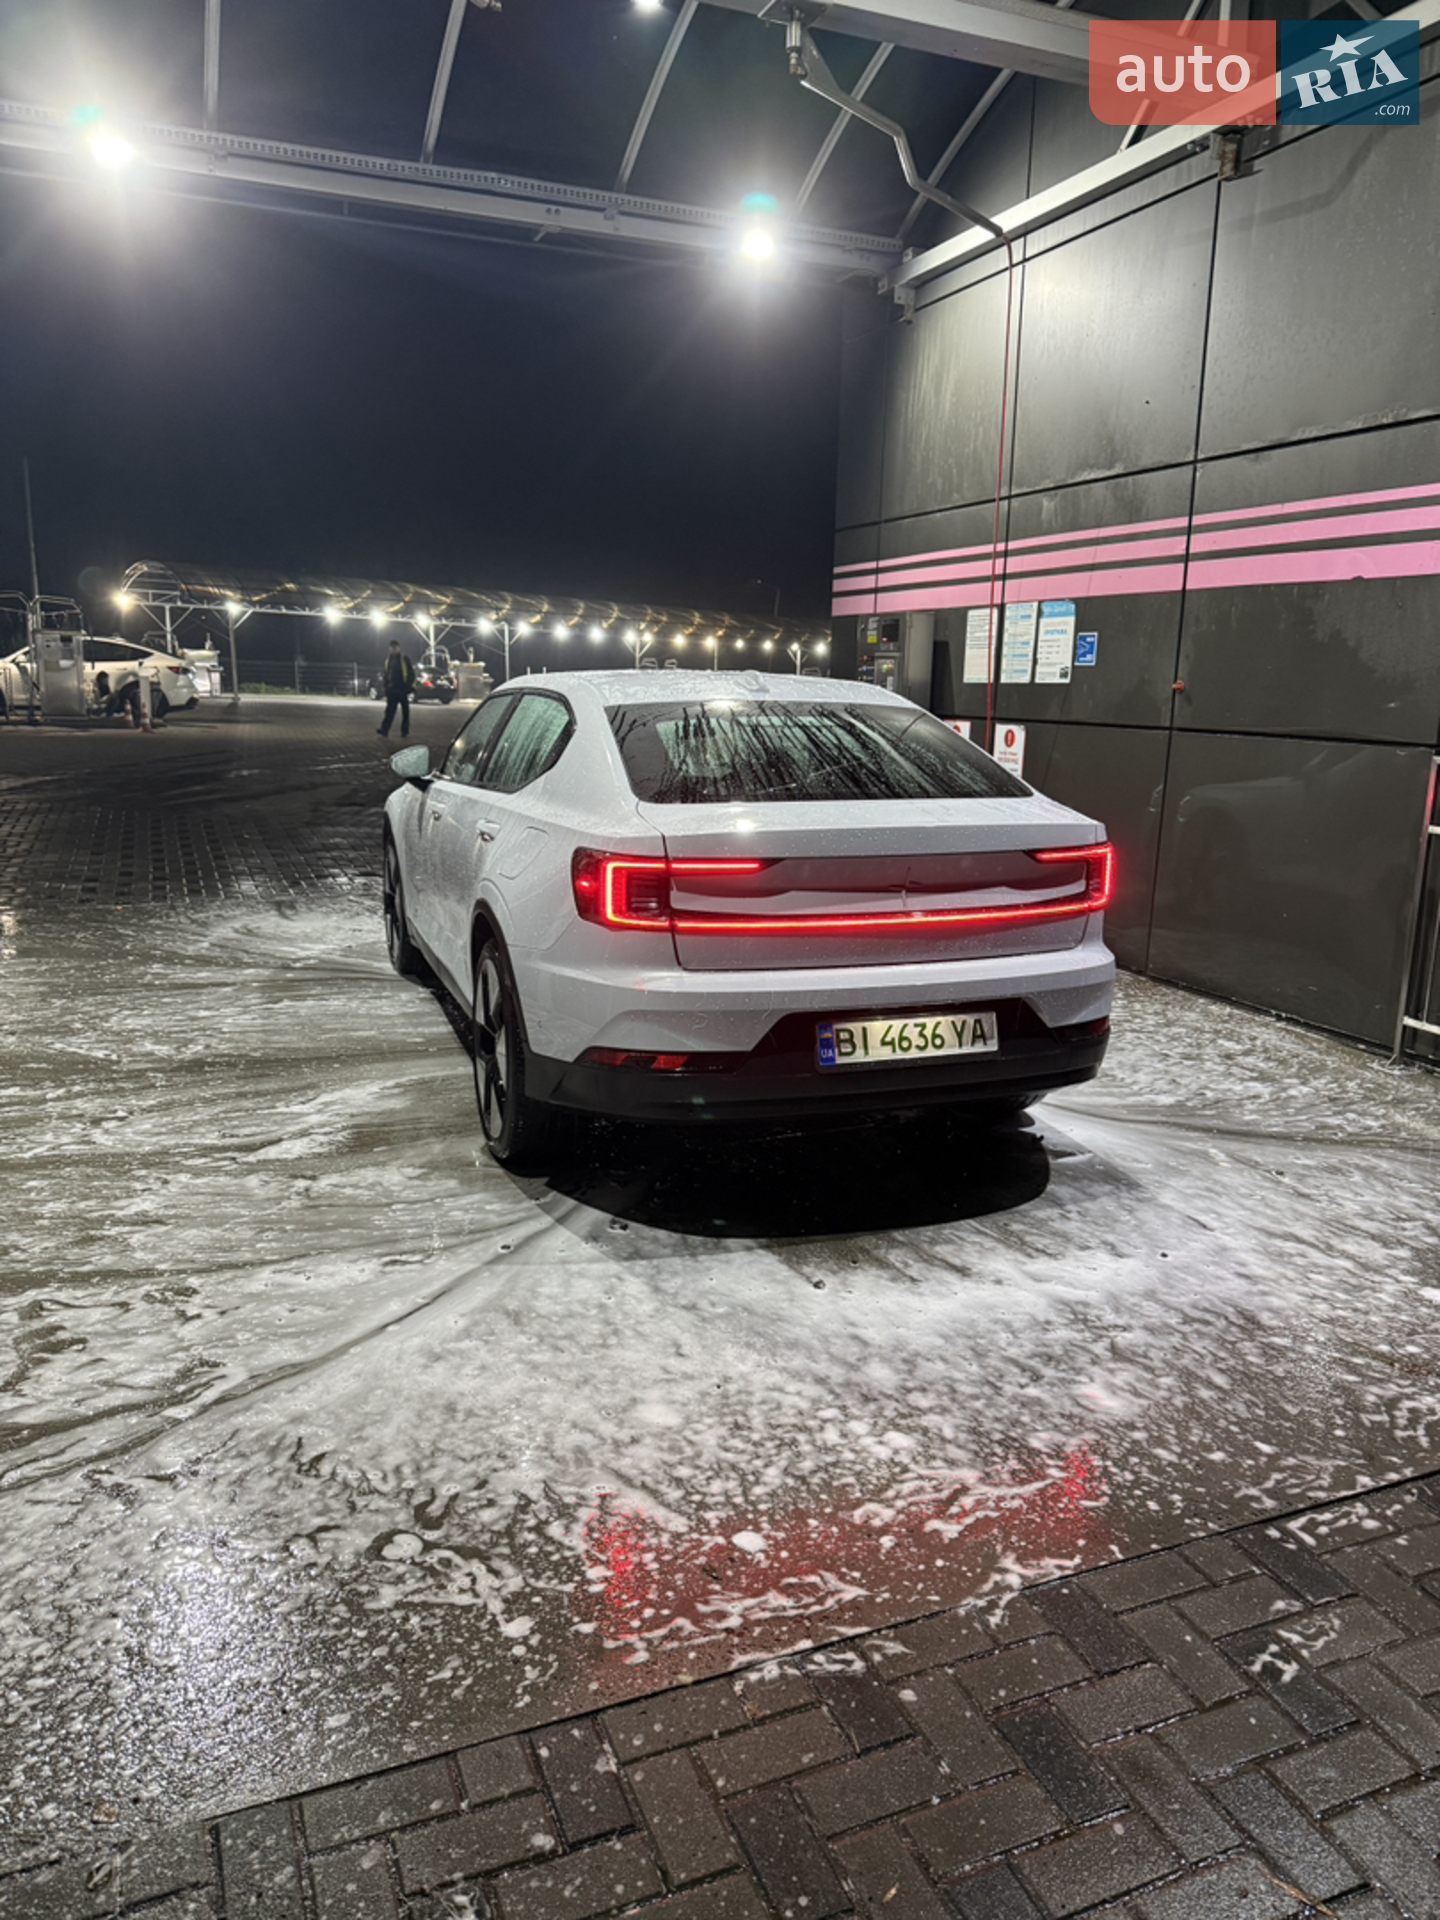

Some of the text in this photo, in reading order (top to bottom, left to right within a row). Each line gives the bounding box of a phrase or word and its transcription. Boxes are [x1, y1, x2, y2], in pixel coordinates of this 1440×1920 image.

[835, 1018, 989, 1058] BI 4636 YA
[820, 1048, 835, 1059] UA
